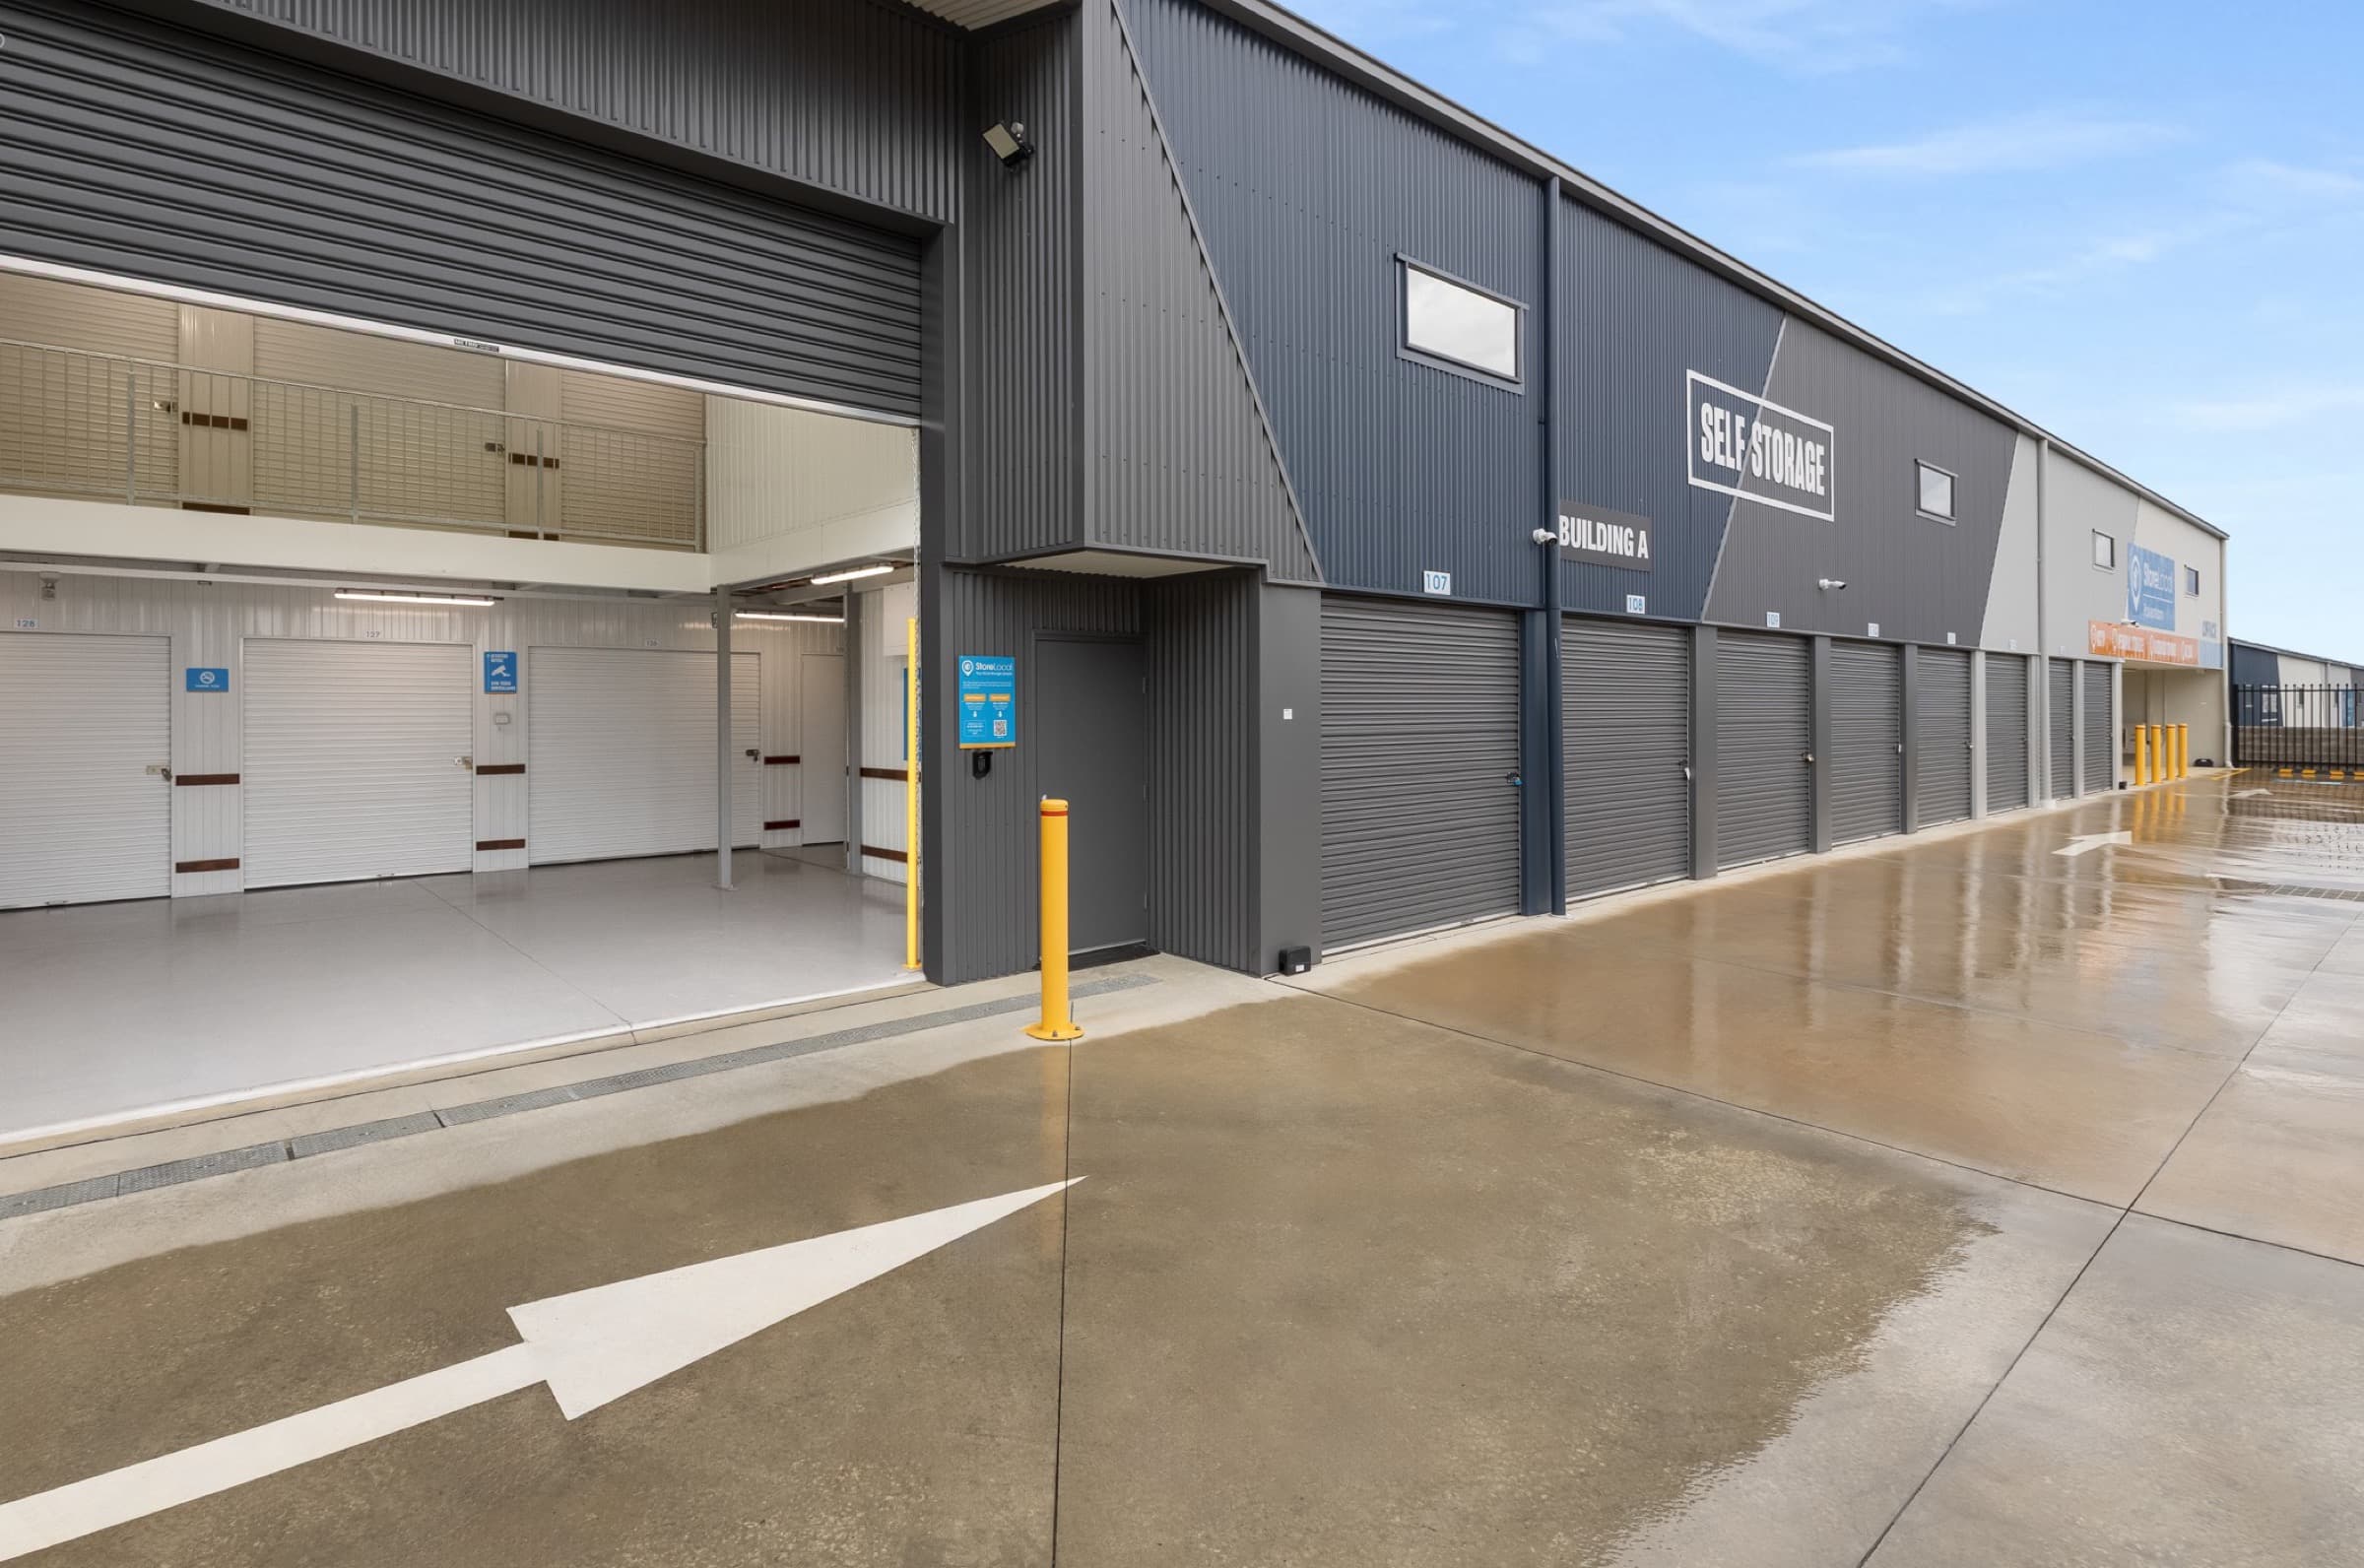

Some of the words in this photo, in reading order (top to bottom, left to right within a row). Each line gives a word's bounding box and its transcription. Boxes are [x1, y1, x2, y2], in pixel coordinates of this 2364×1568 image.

[1701, 403, 1744, 472] SELF
[1751, 422, 1825, 495] STORAGE
[1559, 514, 1634, 557] BUILDING
[1637, 530, 1649, 559] A
[1426, 573, 1447, 591] 107
